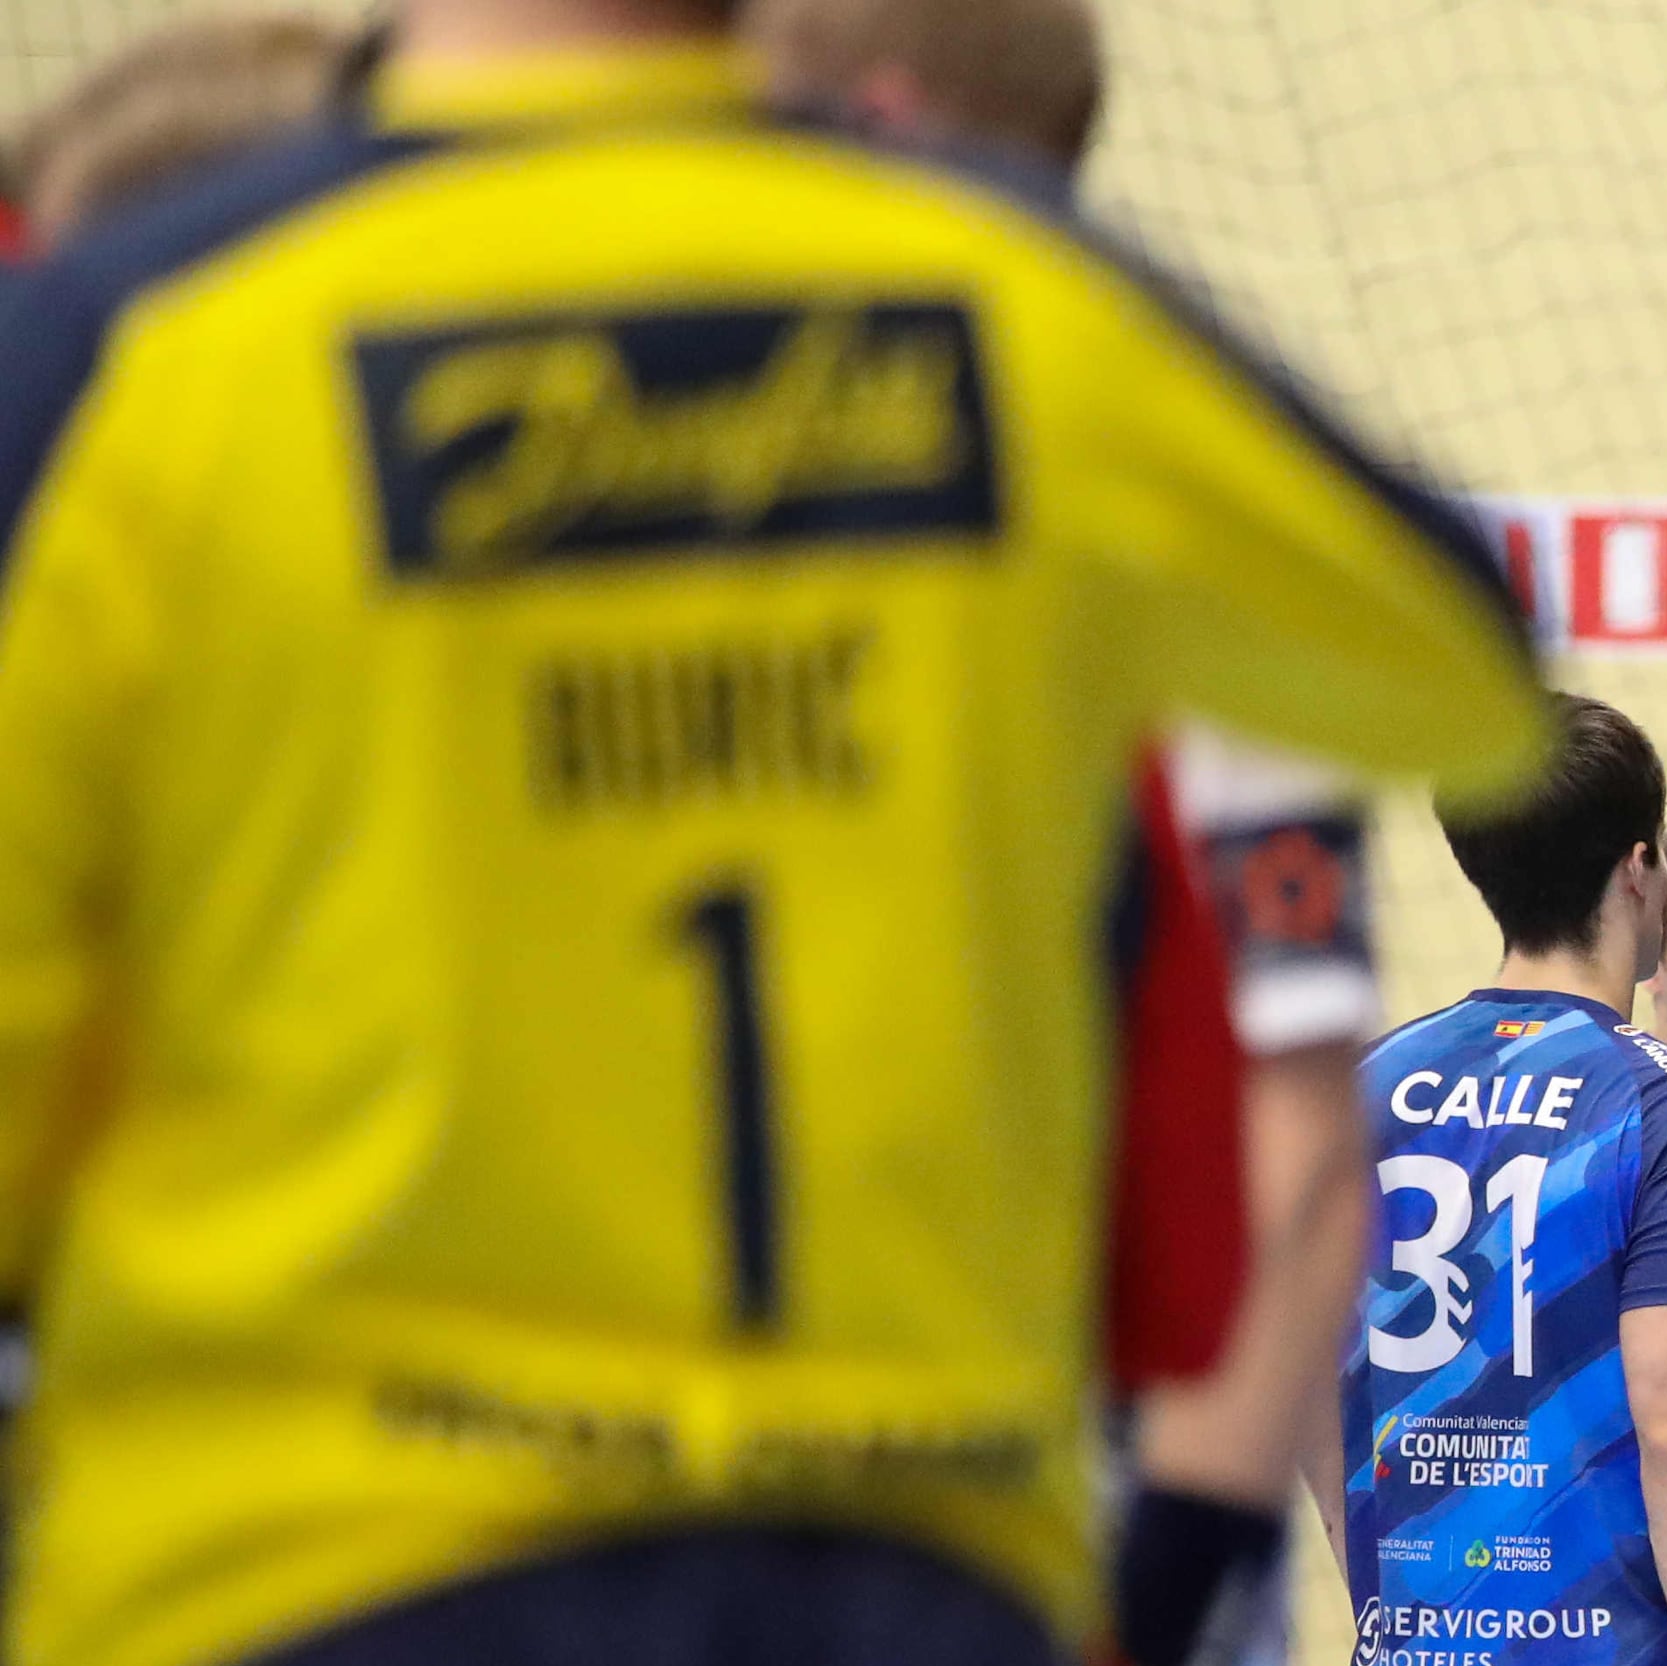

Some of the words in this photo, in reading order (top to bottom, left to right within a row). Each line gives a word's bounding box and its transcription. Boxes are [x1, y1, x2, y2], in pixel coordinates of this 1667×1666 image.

[1391, 1070, 1583, 1130] CALLE
[1368, 1154, 1549, 1377] 31
[1403, 1413, 1475, 1430] Comunitat
[1475, 1416, 1529, 1431] Valencia
[1410, 1461, 1445, 1485] DE
[1377, 1538, 1434, 1550] ENERALITAT
[1377, 1551, 1431, 1562] ALENCIANA
[1384, 1607, 1611, 1639] SERVIGROUP
